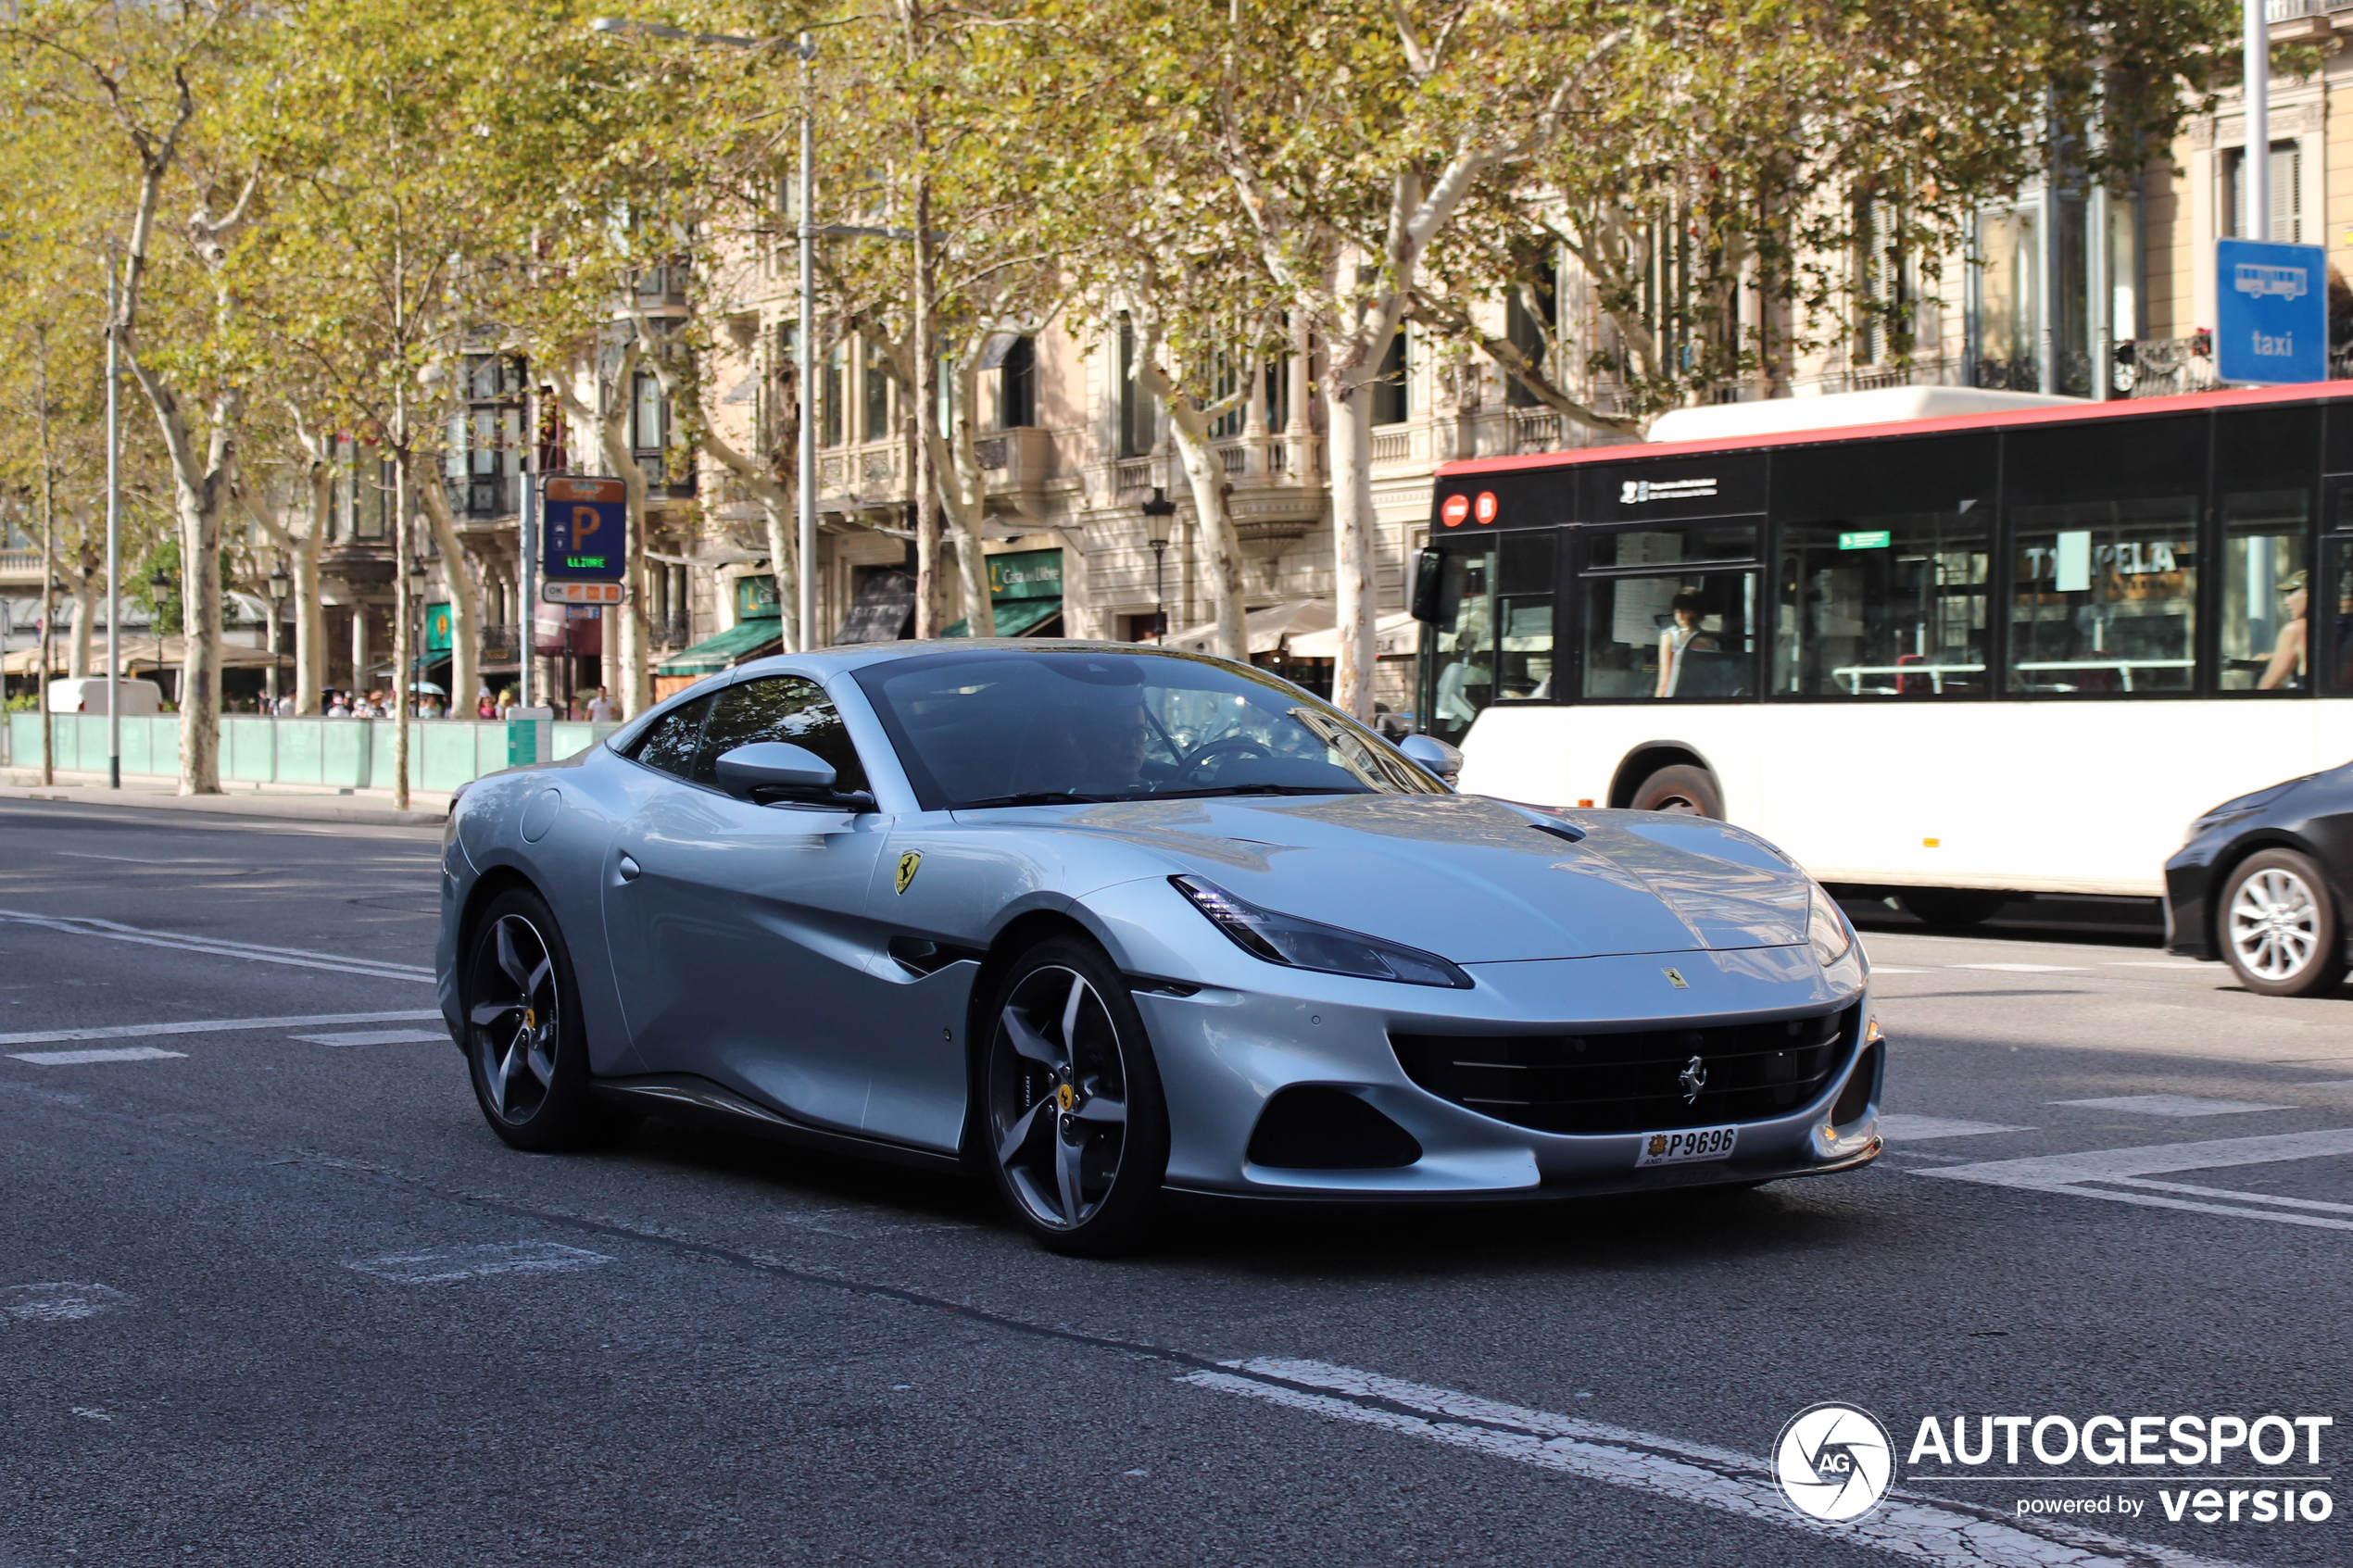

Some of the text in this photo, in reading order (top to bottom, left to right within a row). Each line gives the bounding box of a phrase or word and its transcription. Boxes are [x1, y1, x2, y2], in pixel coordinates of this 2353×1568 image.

[2252, 331, 2294, 357] taxi
[1479, 498, 1492, 518] B
[573, 506, 600, 550] P
[1002, 568, 1024, 584] Casa
[1667, 1128, 1733, 1157] P9696
